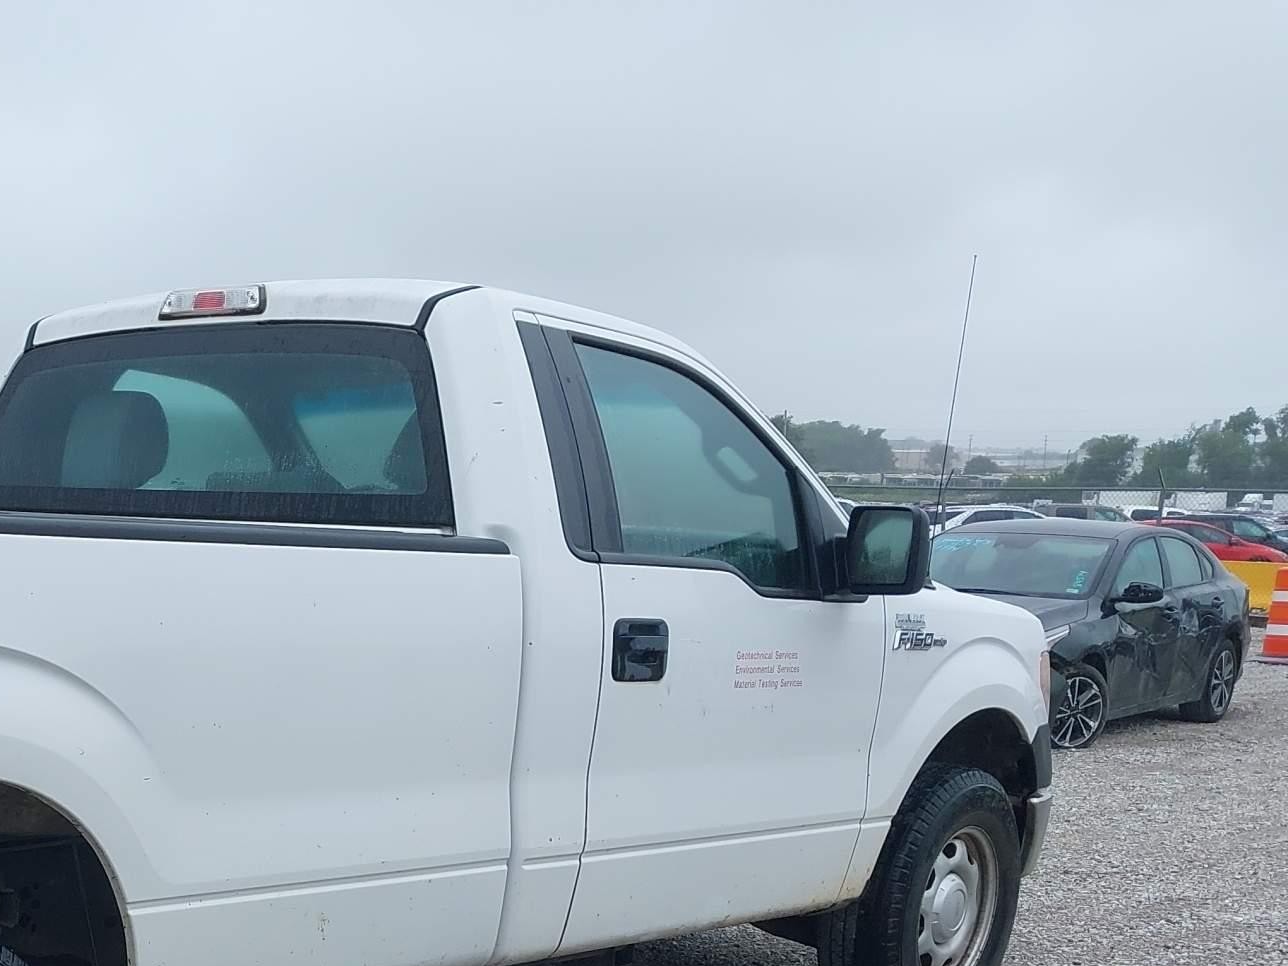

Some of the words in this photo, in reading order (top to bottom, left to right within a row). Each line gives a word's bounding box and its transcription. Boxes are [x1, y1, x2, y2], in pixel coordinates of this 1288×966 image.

[736, 650, 773, 660] Geotechnical
[775, 650, 799, 660] Services
[735, 664, 775, 674] Environmental
[777, 664, 800, 674] Services
[733, 679, 757, 689] Material
[758, 679, 779, 690] Testing
[780, 678, 803, 688] Services
